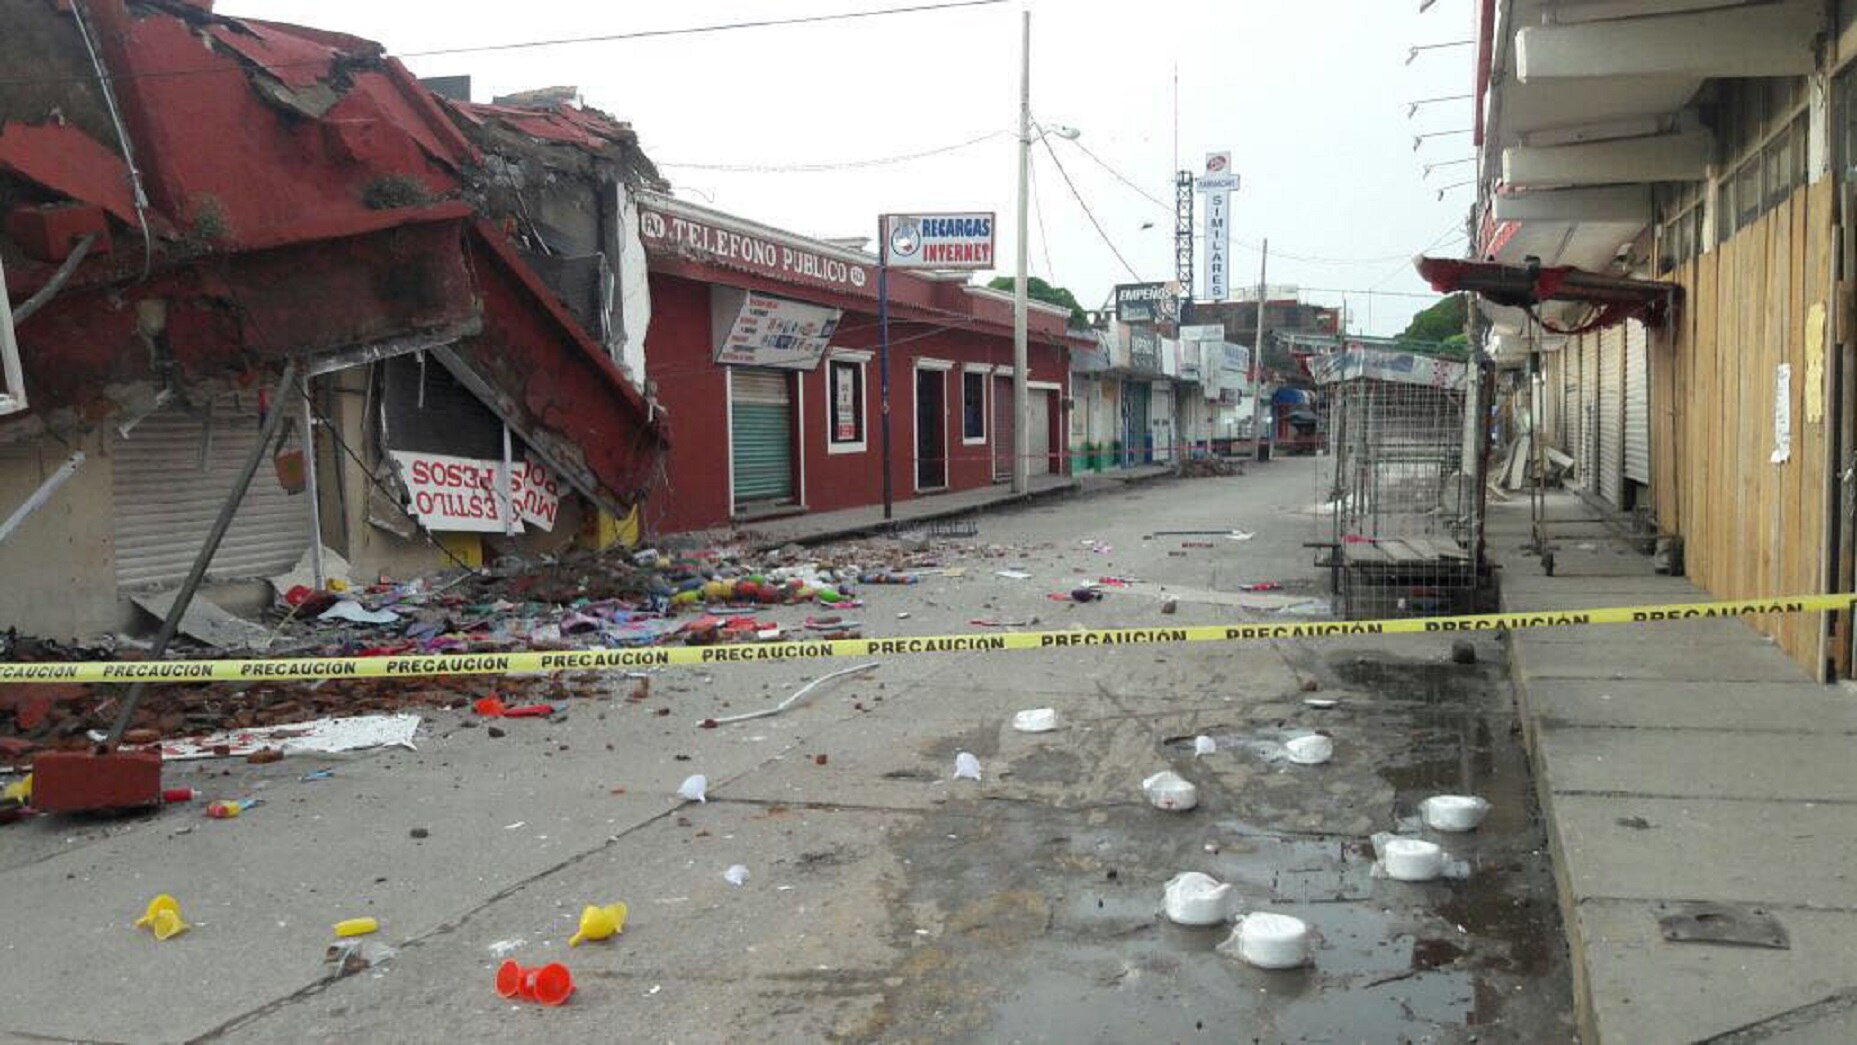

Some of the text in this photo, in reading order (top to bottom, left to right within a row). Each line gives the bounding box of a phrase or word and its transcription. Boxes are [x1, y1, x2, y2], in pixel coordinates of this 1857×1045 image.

[922, 218, 990, 237] RECARGAS
[673, 218, 847, 282] TELEFONO PUBLICO
[923, 242, 990, 262] INTERNET
[1211, 195, 1223, 296] SIMILARES
[412, 460, 493, 490] PESOS
[415, 491, 499, 521] ESTILO
